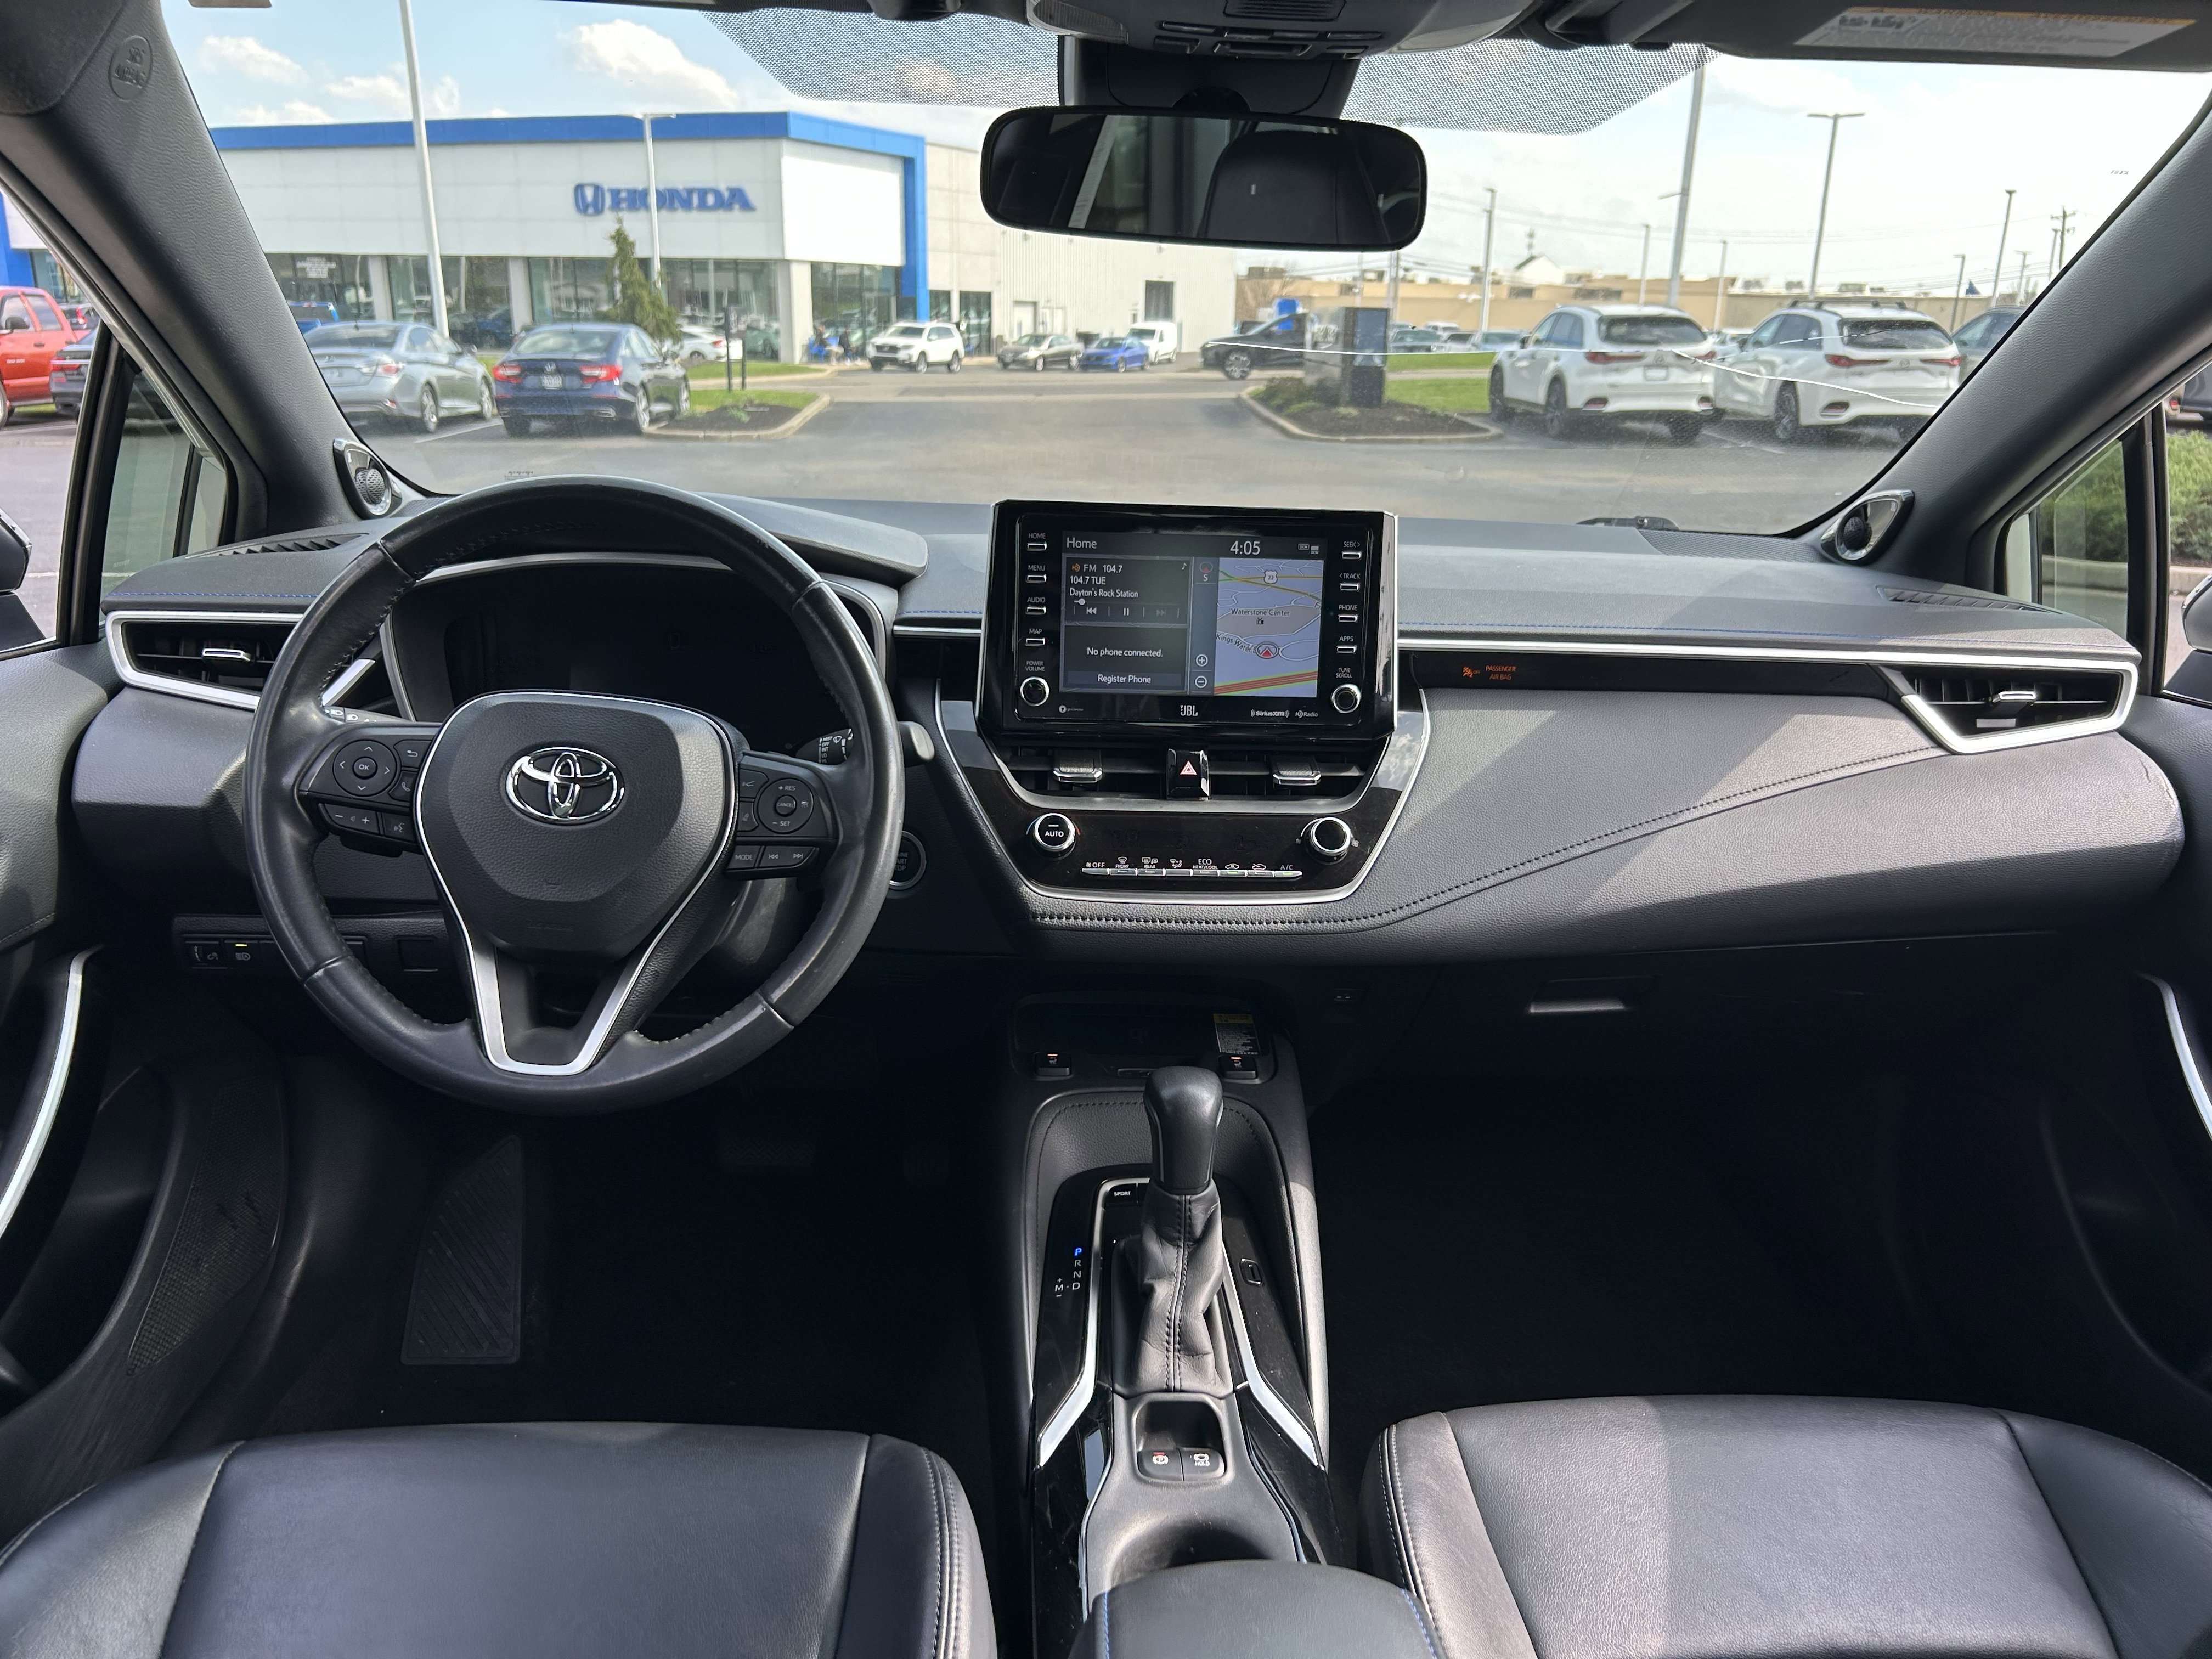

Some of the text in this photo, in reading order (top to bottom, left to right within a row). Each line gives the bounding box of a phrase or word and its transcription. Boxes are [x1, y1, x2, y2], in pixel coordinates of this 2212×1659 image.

[608, 187, 756, 211] HONDA
[1066, 537, 1097, 549] Home
[1230, 540, 1261, 555] 4:05
[1084, 564, 1097, 572] FM
[1103, 565, 1122, 573] 104.7
[1070, 575, 1106, 585] 104.7 TUE
[1070, 588, 1138, 598] Dayton's Rock Station
[1216, 634, 1233, 644] Kings
[1234, 639, 1251, 652] Water
[1087, 647, 1163, 657] No phone connected.
[1098, 674, 1152, 684] Register Phone
[1181, 705, 1198, 716] JBL
[1075, 1248, 1082, 1256] P
[1073, 1270, 1082, 1279] N
[1055, 1282, 1081, 1292] M D
